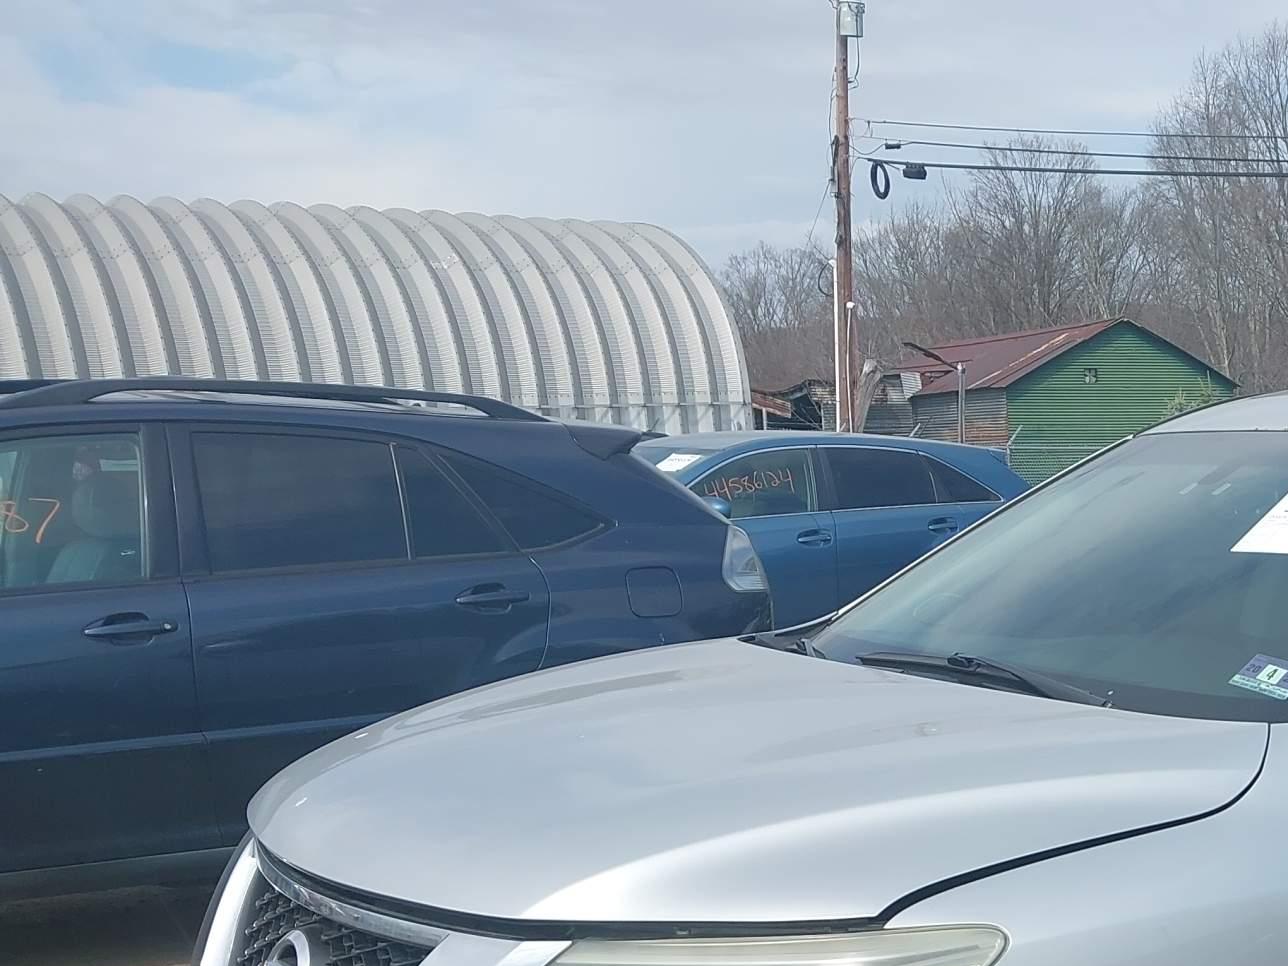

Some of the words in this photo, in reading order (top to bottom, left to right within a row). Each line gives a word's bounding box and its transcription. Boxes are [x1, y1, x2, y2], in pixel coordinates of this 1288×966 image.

[703, 467, 796, 501] 44586124
[0, 497, 60, 544] 87
[1266, 668, 1279, 681] 4
